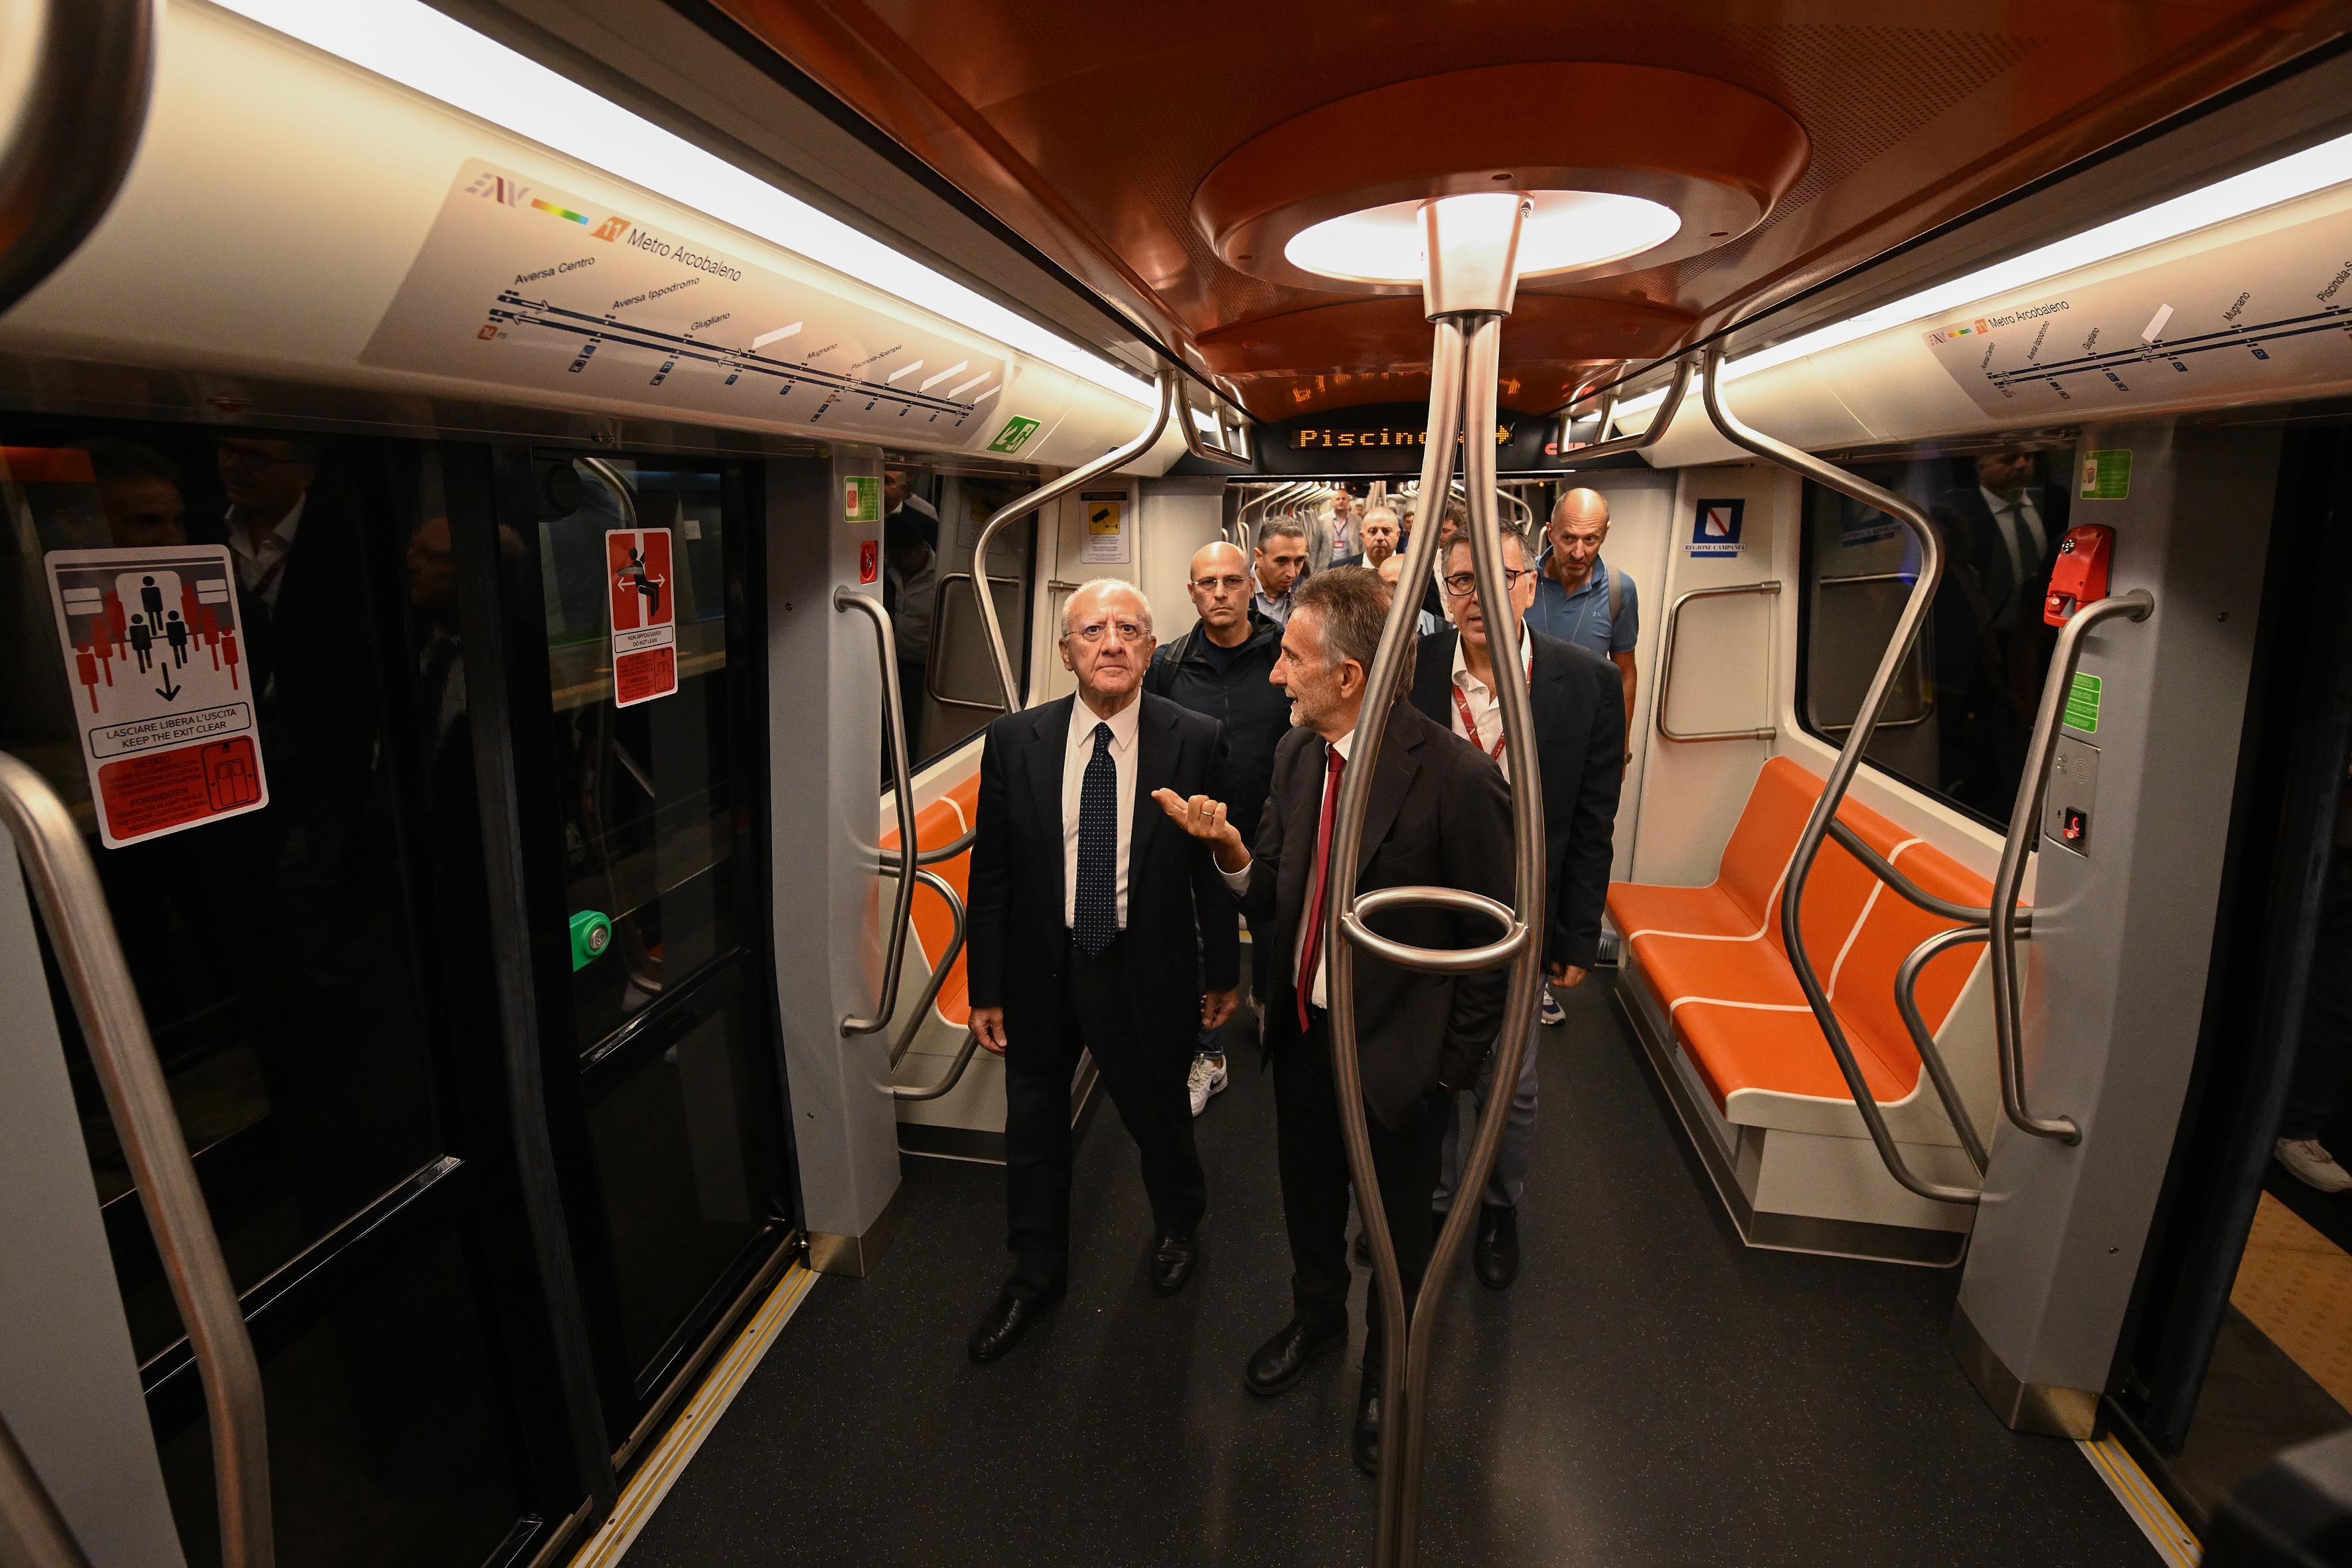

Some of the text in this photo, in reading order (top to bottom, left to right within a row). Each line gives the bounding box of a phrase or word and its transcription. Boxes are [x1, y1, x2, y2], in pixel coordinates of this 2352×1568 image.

[603, 220, 742, 282] 11 Metro Arcobaleno
[514, 257, 595, 285] Aversa Centro
[612, 277, 700, 310] Aversa Ippodromo
[2223, 291, 2250, 321] Mugnano
[690, 313, 731, 331] Giugliano
[1975, 300, 2070, 332] 11 Metro Arcobaleno
[807, 343, 838, 360] Mugnano
[2026, 321, 2050, 361] Aversa Ippodromo
[2082, 327, 2100, 350] Giugliano
[1299, 428, 1462, 445] Piscin
[106, 708, 237, 740] LASCIARE LIBERA L'USCITA
[122, 721, 227, 749] KEEP THE EXIT CLEAR
[129, 787, 189, 807] FORBIDDEN
